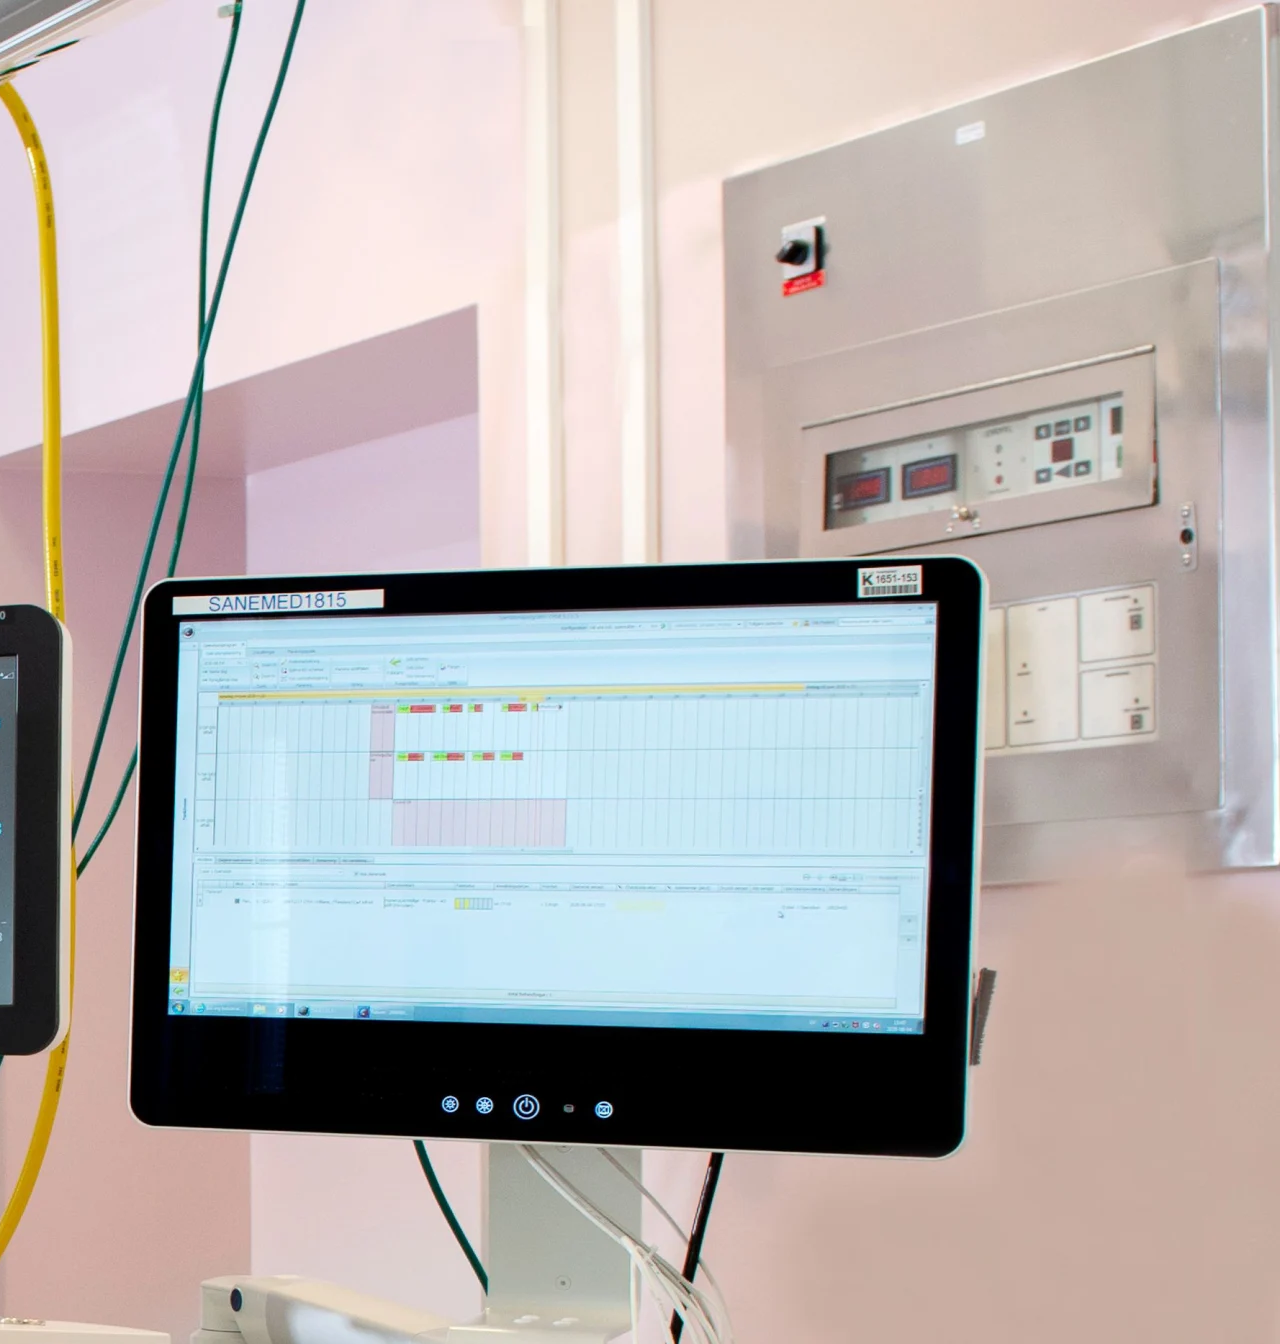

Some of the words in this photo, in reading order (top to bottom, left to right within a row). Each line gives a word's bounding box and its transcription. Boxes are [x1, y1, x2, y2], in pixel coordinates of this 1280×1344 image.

[862, 573, 874, 586] K
[875, 572, 918, 584] 1651-153
[209, 592, 347, 612] SANEMED1815
